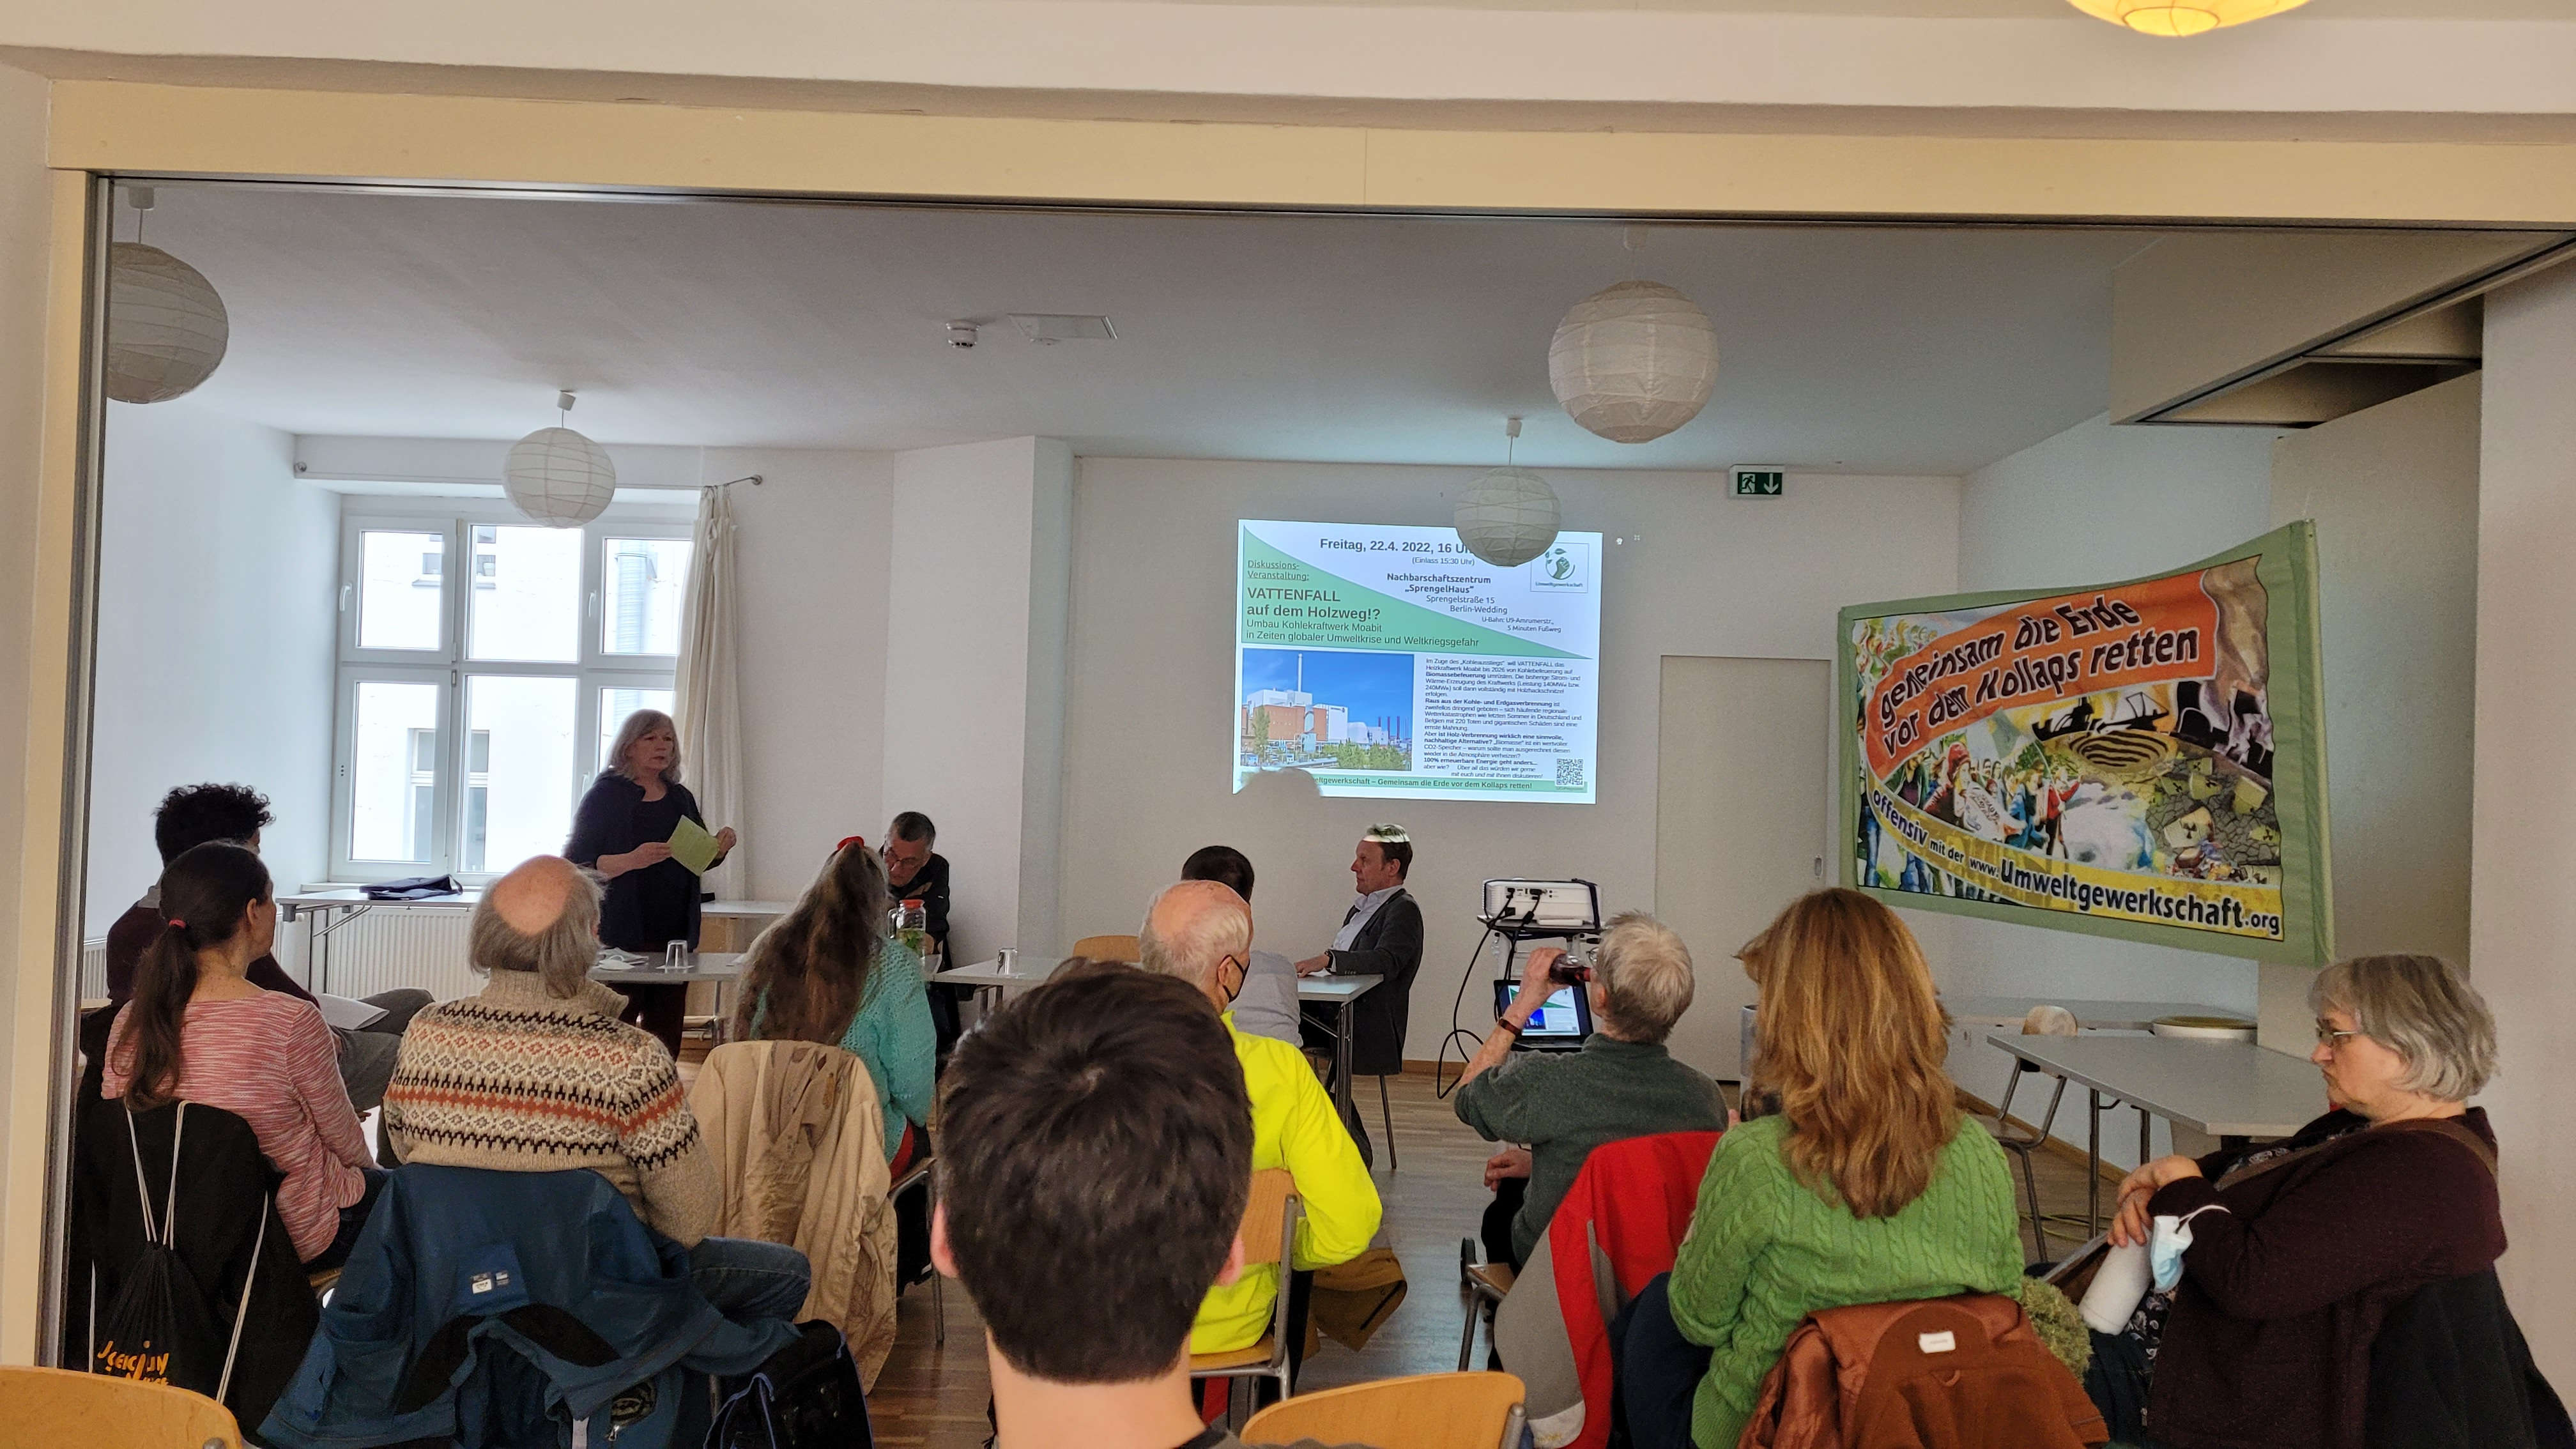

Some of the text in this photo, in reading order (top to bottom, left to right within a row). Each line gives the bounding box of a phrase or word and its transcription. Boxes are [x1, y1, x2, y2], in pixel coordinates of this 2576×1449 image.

[1320, 539, 1367, 552] Freitag,
[1370, 541, 1398, 551] 22.4.
[1402, 542, 1434, 555] 2022,
[1438, 543, 1452, 553] 16
[1248, 560, 1300, 570] Diskussions-
[1412, 556, 1438, 565] (Einlass
[1247, 571, 1309, 581] Veranstaltung:
[1387, 573, 1491, 583] Nachbarschaftszentrum
[1247, 587, 1341, 602] VATTENFALL
[1426, 595, 1484, 604] Sprengelstraße
[1247, 604, 1381, 622] auf dem Holzweg!?
[1450, 605, 1508, 615] Berlin-Wedding
[1246, 618, 1382, 632] Umbau Kohlekraftwerk Moabit
[1257, 631, 1285, 640] Zeiten
[1288, 632, 1324, 642] globaler
[1327, 633, 1382, 643] Umweltkrise
[1384, 636, 1401, 645] und
[1404, 636, 1479, 648] Weltkriegsgefahr
[1881, 595, 2141, 730] gemeinsam die Erde
[1884, 627, 2198, 758] vor dem Kollaps retten
[1314, 777, 1370, 785] eltgewerkschaft
[1482, 781, 1508, 790] Kollaps
[1873, 789, 1929, 845] offensiv
[1929, 839, 1946, 857] mit
[1947, 847, 1965, 864] der
